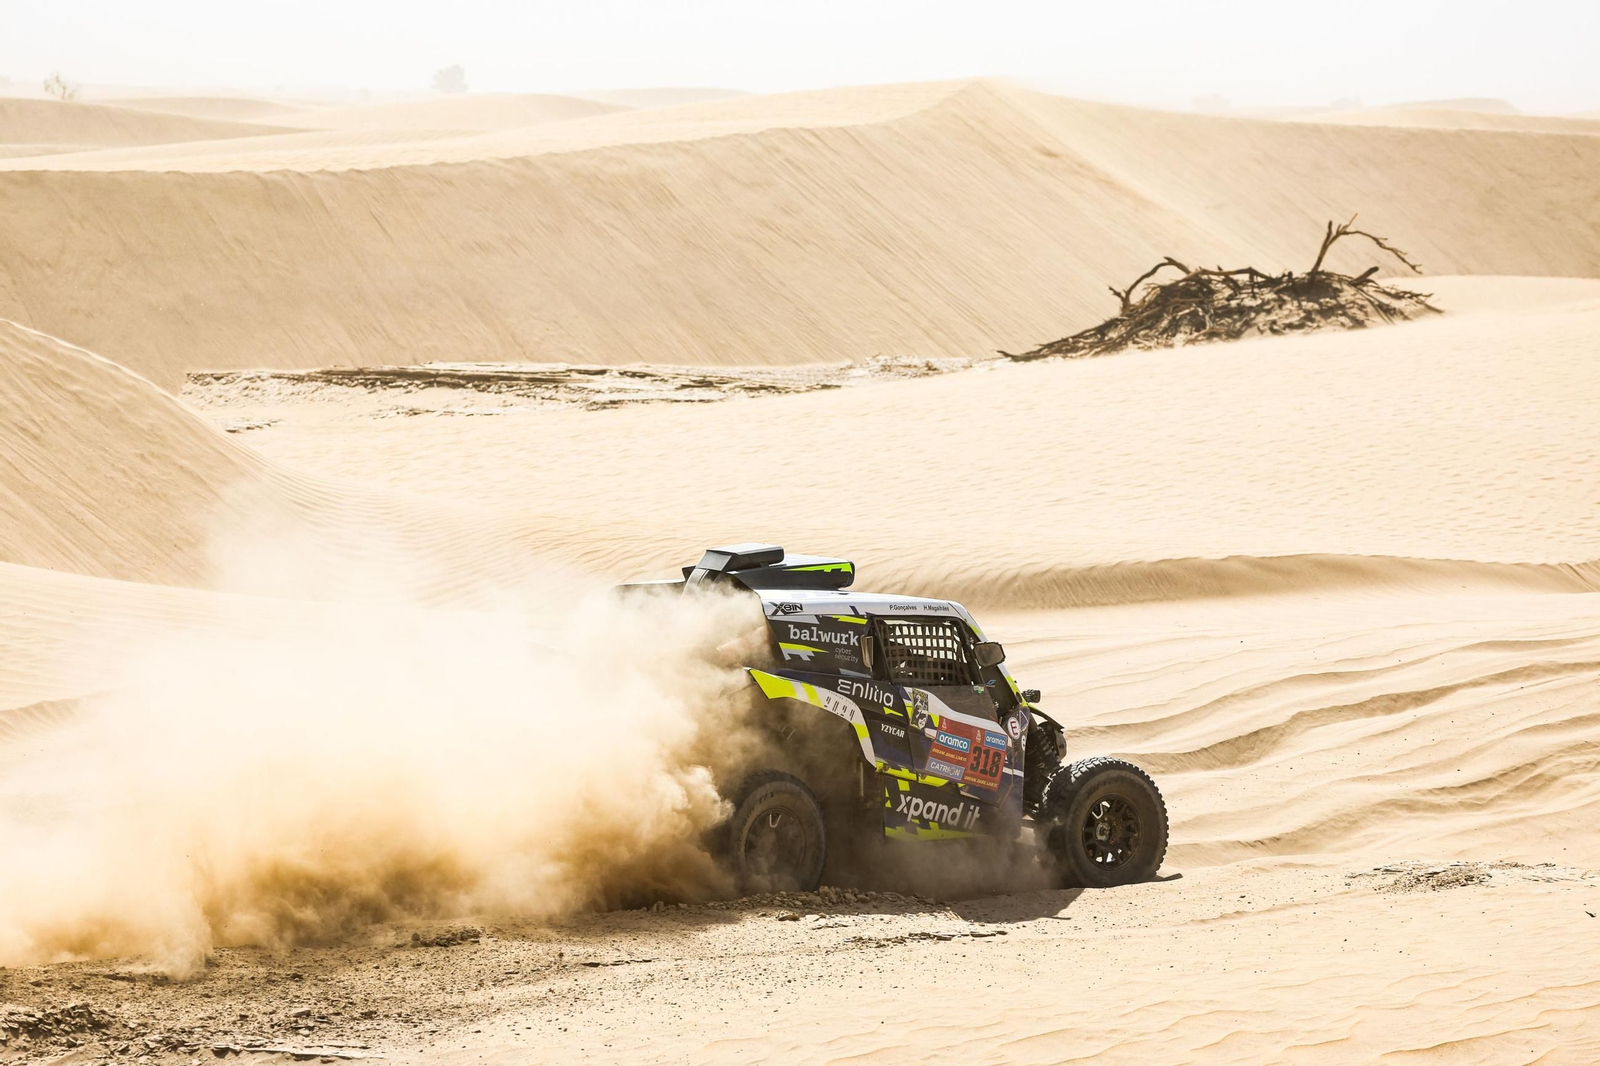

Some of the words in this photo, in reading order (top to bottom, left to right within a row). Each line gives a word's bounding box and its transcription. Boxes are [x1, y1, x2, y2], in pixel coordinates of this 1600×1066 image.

[788, 625, 859, 646] balwurk
[835, 647, 852, 655] cyber
[834, 654, 859, 663] security
[881, 724, 905, 738] YZYCAR
[939, 735, 967, 749] aramco
[986, 736, 1006, 746] aramco
[970, 746, 1001, 777] 318
[896, 794, 964, 826] xpand
[963, 805, 980, 829] it
